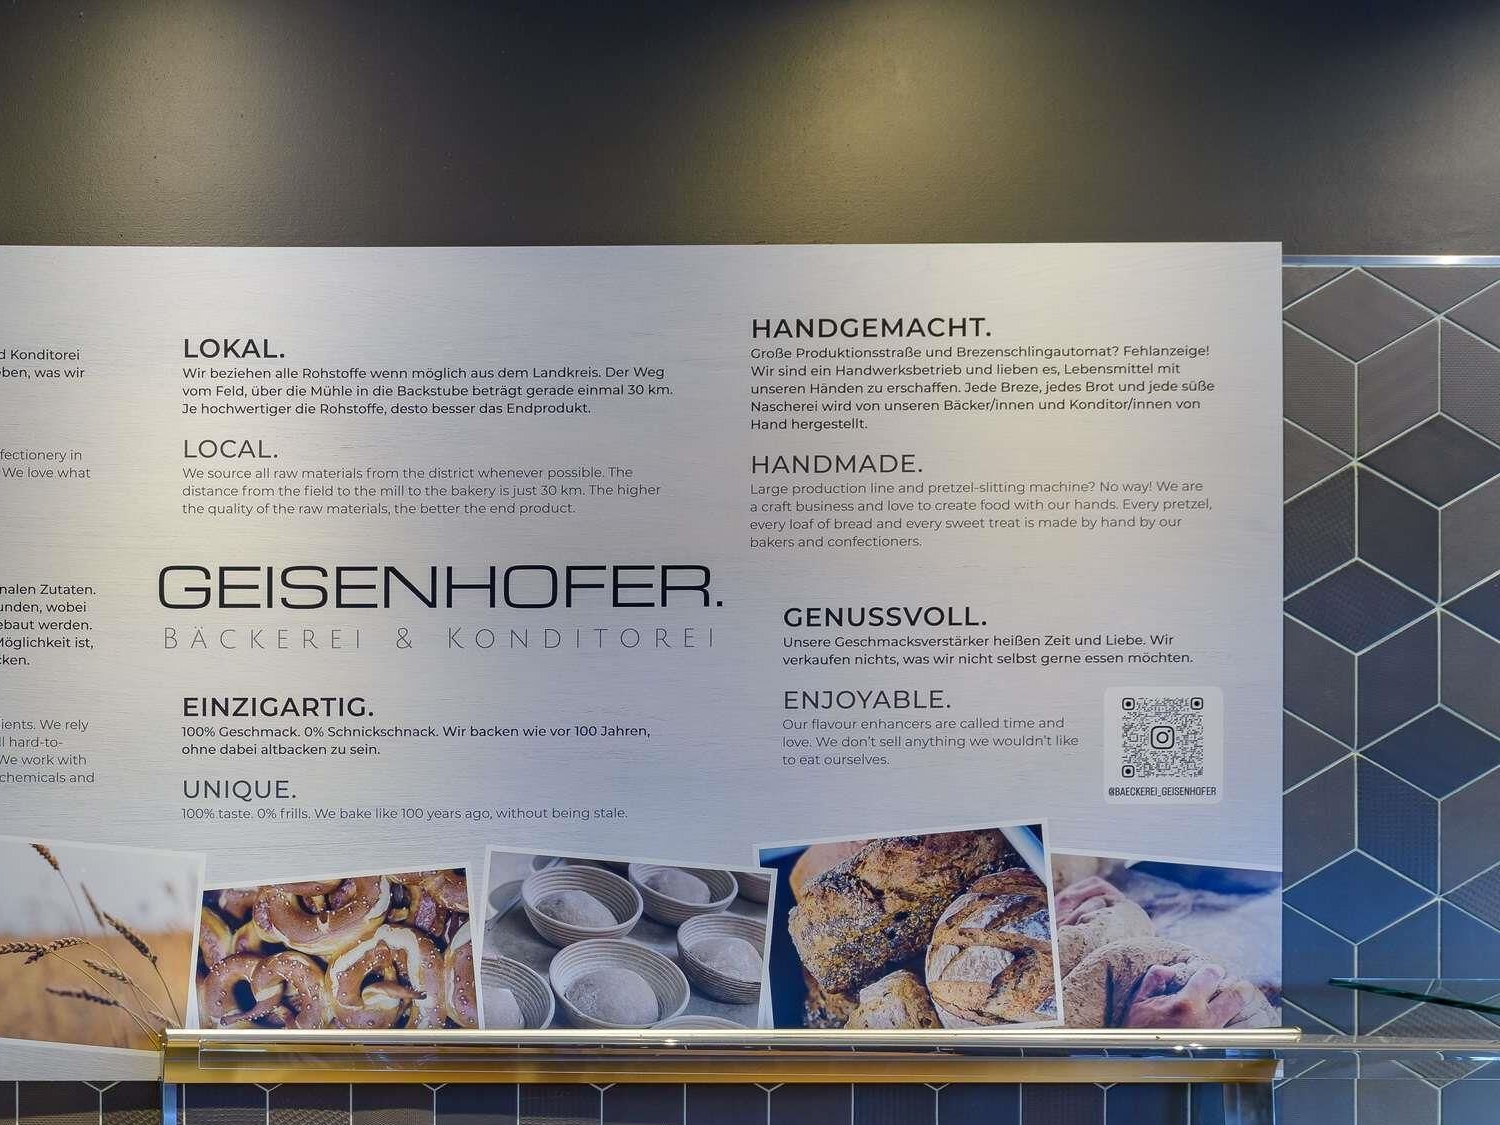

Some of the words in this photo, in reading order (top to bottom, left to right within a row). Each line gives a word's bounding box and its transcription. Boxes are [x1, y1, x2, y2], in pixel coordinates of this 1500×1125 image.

[752, 316, 991, 339] HANDGEMACHT.
[11, 349, 79, 360] Konditorei
[183, 338, 285, 359] LOKAL.
[749, 347, 791, 358] Große
[796, 346, 921, 358] Produktionsstraße
[926, 346, 952, 357] und
[957, 346, 1118, 359] Brezenschlingautomat?
[1124, 345, 1209, 358] Fehlanzeige!
[182, 367, 206, 378] Wir
[210, 367, 270, 378] beziehen
[275, 368, 298, 378] alle
[303, 368, 366, 378] Rohstoffe
[370, 370, 407, 378] wenn
[412, 367, 466, 380] möglich
[471, 370, 494, 378] aus
[497, 368, 528, 377] dem
[533, 366, 601, 377] Landkreis.
[606, 367, 629, 377] Der
[633, 367, 664, 379] Weg
[180, 403, 197, 413] Je
[201, 403, 291, 416] hochwertiger
[295, 403, 315, 414] die
[320, 403, 386, 415] Rohstoffe,
[390, 403, 428, 415] desto
[432, 403, 475, 413] besser
[479, 403, 502, 413] das
[507, 402, 590, 415] Endprodukt.
[751, 400, 817, 413] Nascherei
[821, 400, 851, 411] wird
[855, 401, 879, 411] von
[885, 402, 939, 410] unseren
[944, 397, 1034, 411] Bäcker/innen
[1039, 399, 1064, 409] und
[1070, 397, 1171, 410] Konditor/innen
[1176, 401, 1200, 409] von
[751, 418, 786, 429] Hand
[791, 417, 867, 431] hergestellt.
[183, 439, 278, 459] LOCAL.
[751, 453, 923, 474] HANDMADE.
[750, 536, 796, 548] bakers
[798, 536, 823, 547] and
[827, 535, 921, 550] confectioners.
[40, 584, 96, 594] Zutaten.
[158, 564, 723, 610] GEISENHOFER.
[783, 605, 987, 628] GENUSSVOLL.
[38, 619, 92, 630] werden.
[163, 625, 360, 650] BÄCKEREI
[395, 626, 413, 650] &
[446, 626, 713, 649] KONDITOREI
[784, 637, 830, 647] Unsere
[835, 635, 989, 647] Geschmacksverstärker
[994, 635, 1040, 646] heißen
[1044, 635, 1070, 645] Zeit
[1075, 635, 1101, 645] und
[1106, 634, 1145, 645] Liebe.
[1150, 634, 1173, 644] Wir
[783, 654, 850, 665] verkaufen
[855, 653, 899, 666] nichts,
[902, 656, 929, 664] was
[933, 653, 954, 664] wir
[959, 653, 993, 664] nicht
[997, 653, 1037, 663] selbst
[1041, 655, 1081, 666] gerne
[1085, 655, 1123, 663] essen
[1128, 652, 1193, 663] möchten.
[183, 696, 374, 717] EINZIGARTIG.
[784, 689, 951, 710] ENJOYABLE.
[40, 719, 61, 729] We
[65, 719, 88, 732] rely
[181, 727, 215, 737] 100%
[219, 726, 300, 737] Geschmack.
[304, 726, 324, 737] 0%
[325, 726, 438, 737] Schnickschnack.
[442, 726, 466, 736] Wir
[470, 725, 518, 736] backen
[522, 725, 546, 736] wie
[550, 728, 570, 736] vor
[574, 726, 597, 736] 100
[600, 725, 649, 738] Jahren,
[182, 744, 216, 754] ohne
[220, 744, 256, 754] dabei
[261, 744, 326, 754] altbacken
[330, 746, 345, 754] zu
[350, 743, 379, 754] sein.
[183, 779, 296, 802] UNIQUE.
[1108, 786, 1216, 797] @BAECKEREI_GEISENHOFER
